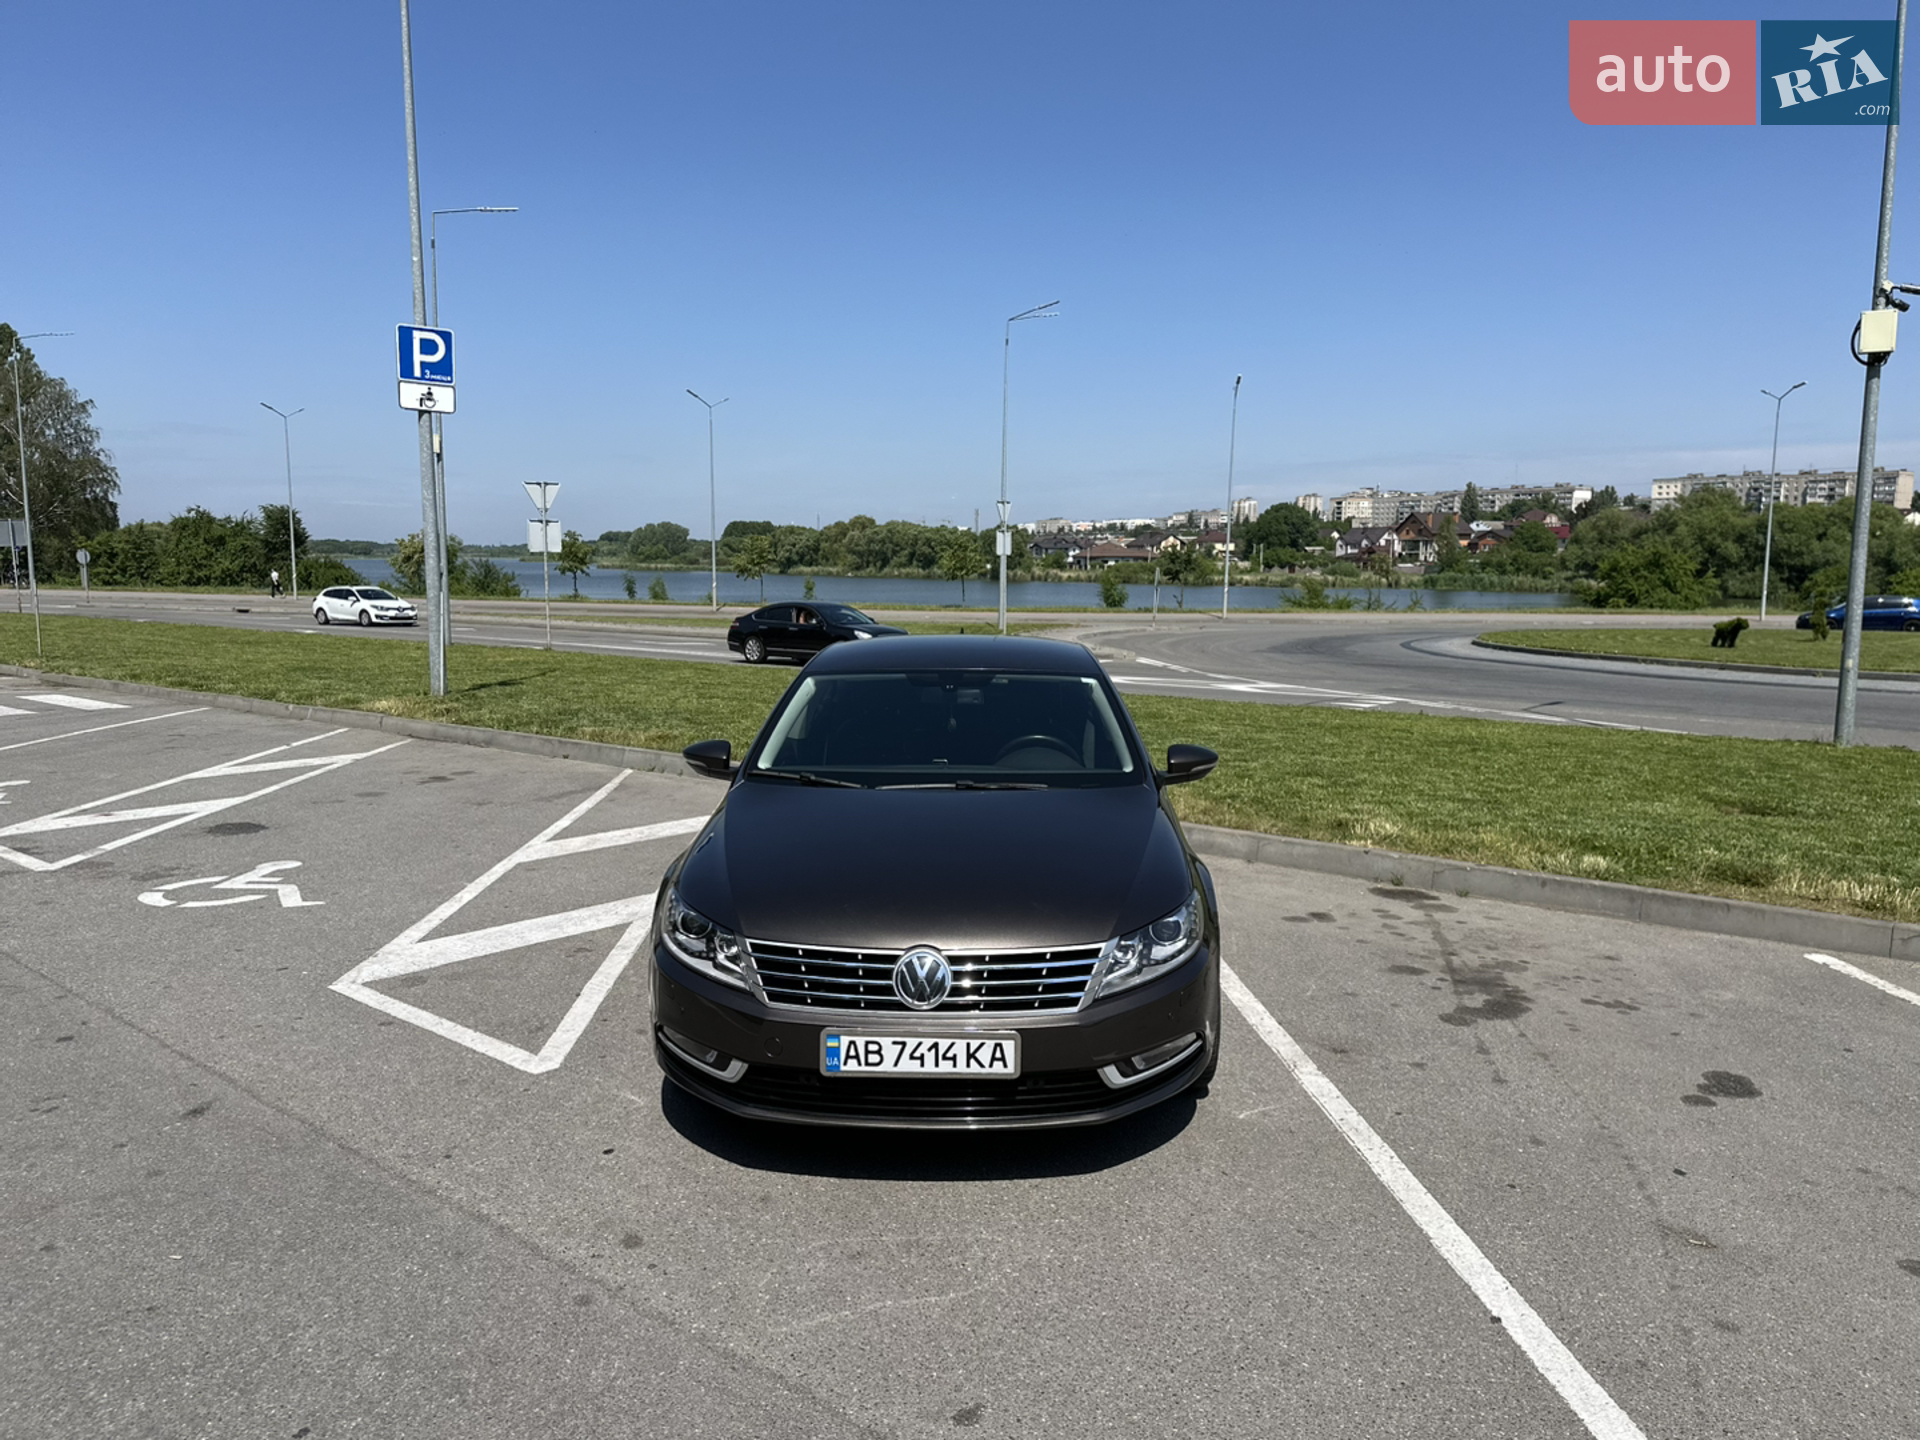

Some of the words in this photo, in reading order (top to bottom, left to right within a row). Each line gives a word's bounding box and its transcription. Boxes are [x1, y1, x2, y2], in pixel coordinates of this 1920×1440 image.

[412, 330, 446, 377] P
[826, 1056, 840, 1066] UA
[843, 1040, 884, 1067] AB
[891, 1041, 957, 1068] 7414
[965, 1042, 1008, 1069] KA
